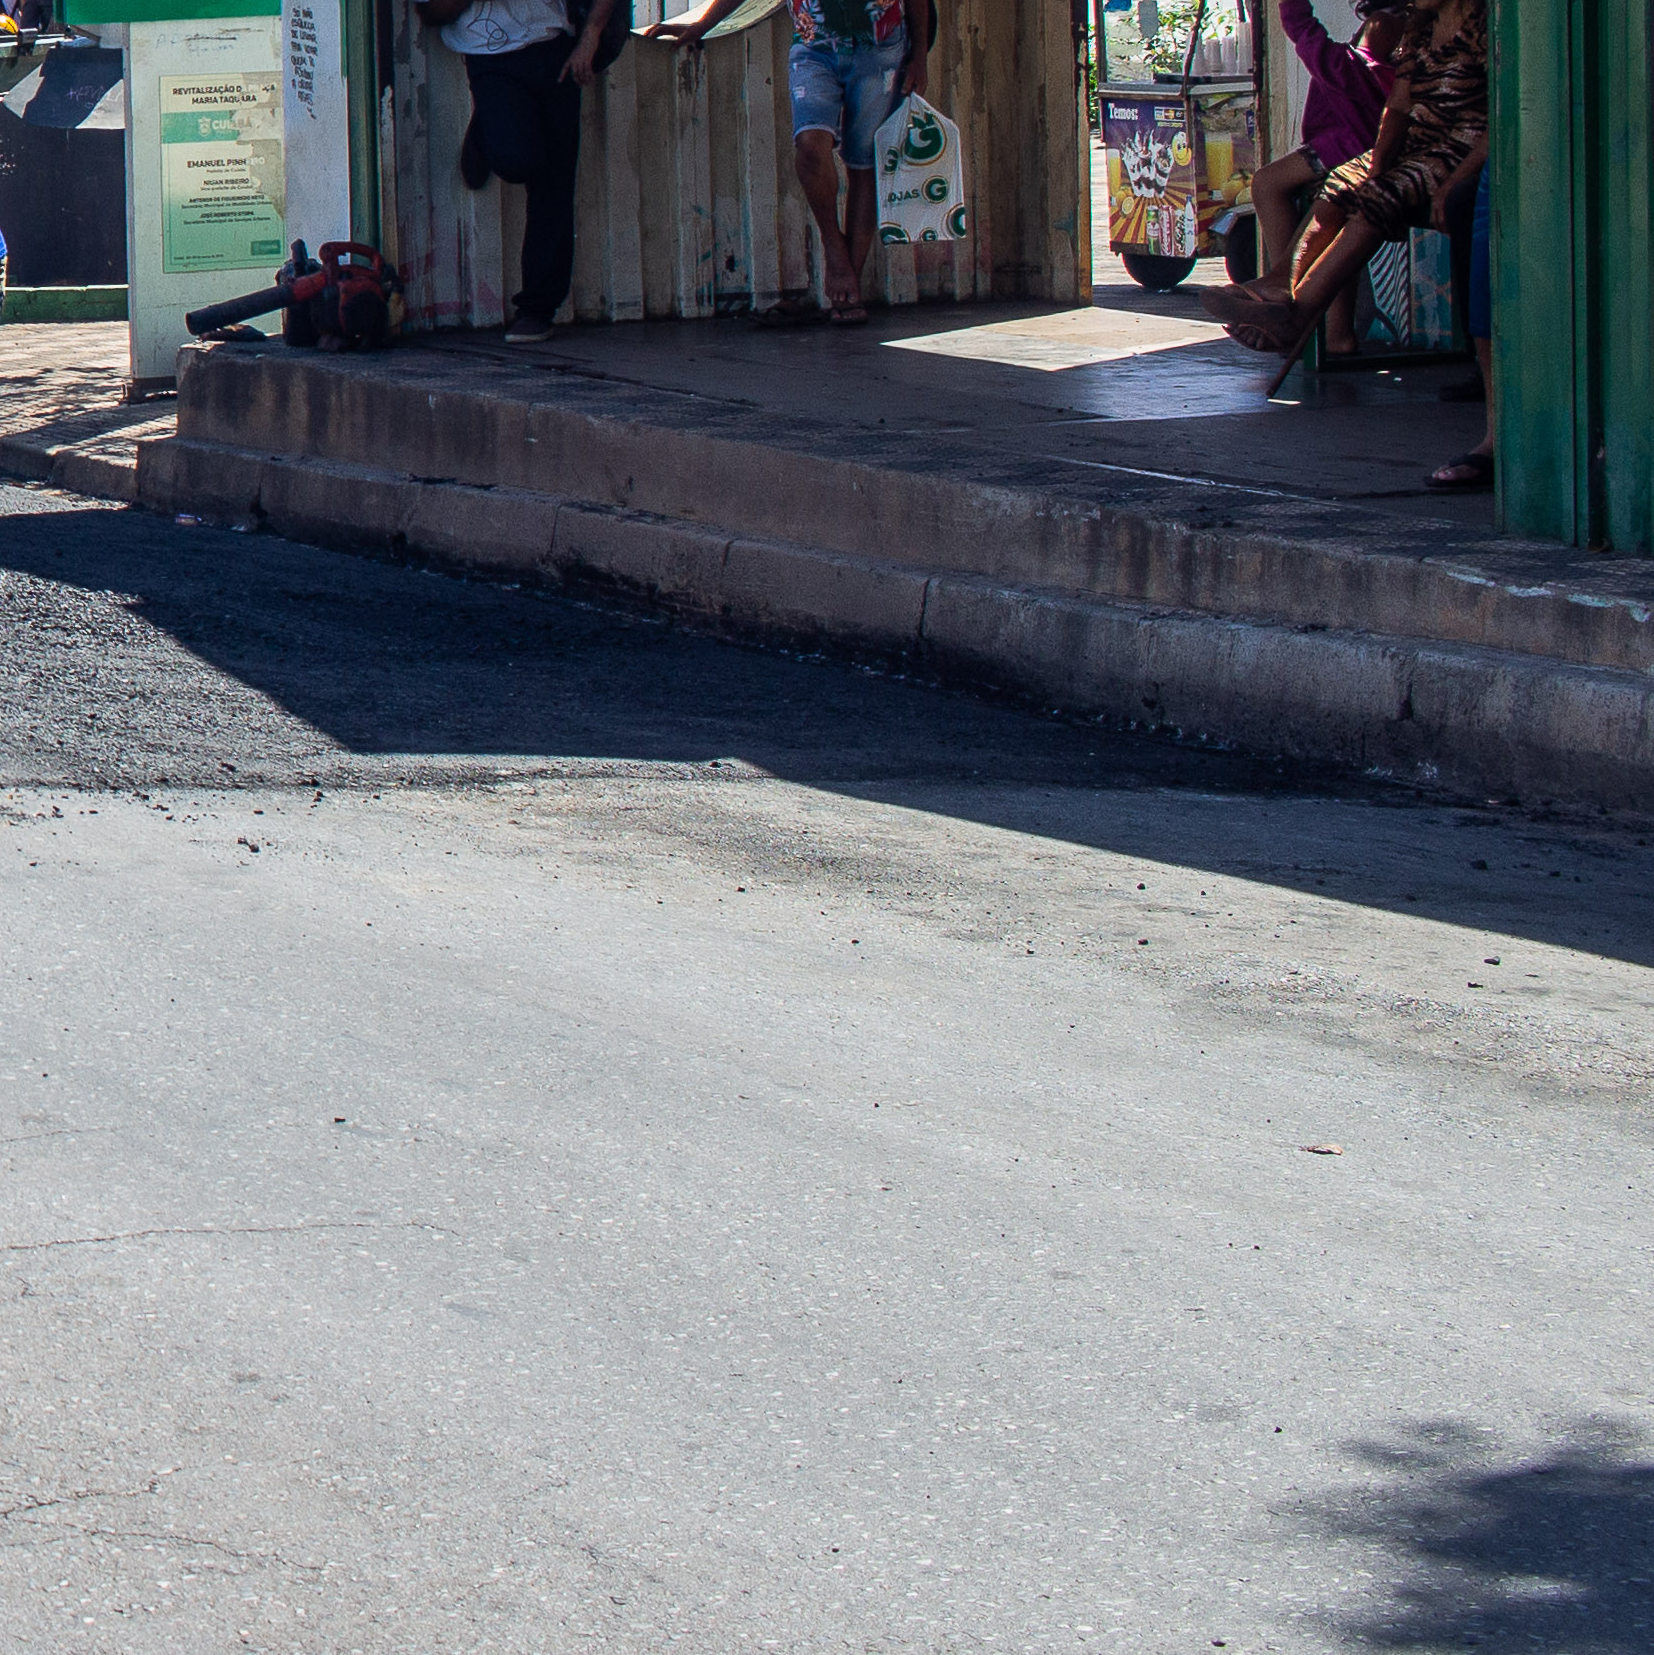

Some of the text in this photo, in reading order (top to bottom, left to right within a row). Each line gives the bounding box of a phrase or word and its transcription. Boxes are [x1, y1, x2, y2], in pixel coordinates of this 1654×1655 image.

[172, 84, 235, 96] REVITALIZAÇÃO
[191, 95, 218, 105] MARIA
[1107, 102, 1139, 121] Temos:
[187, 158, 226, 168] EMANUEL
